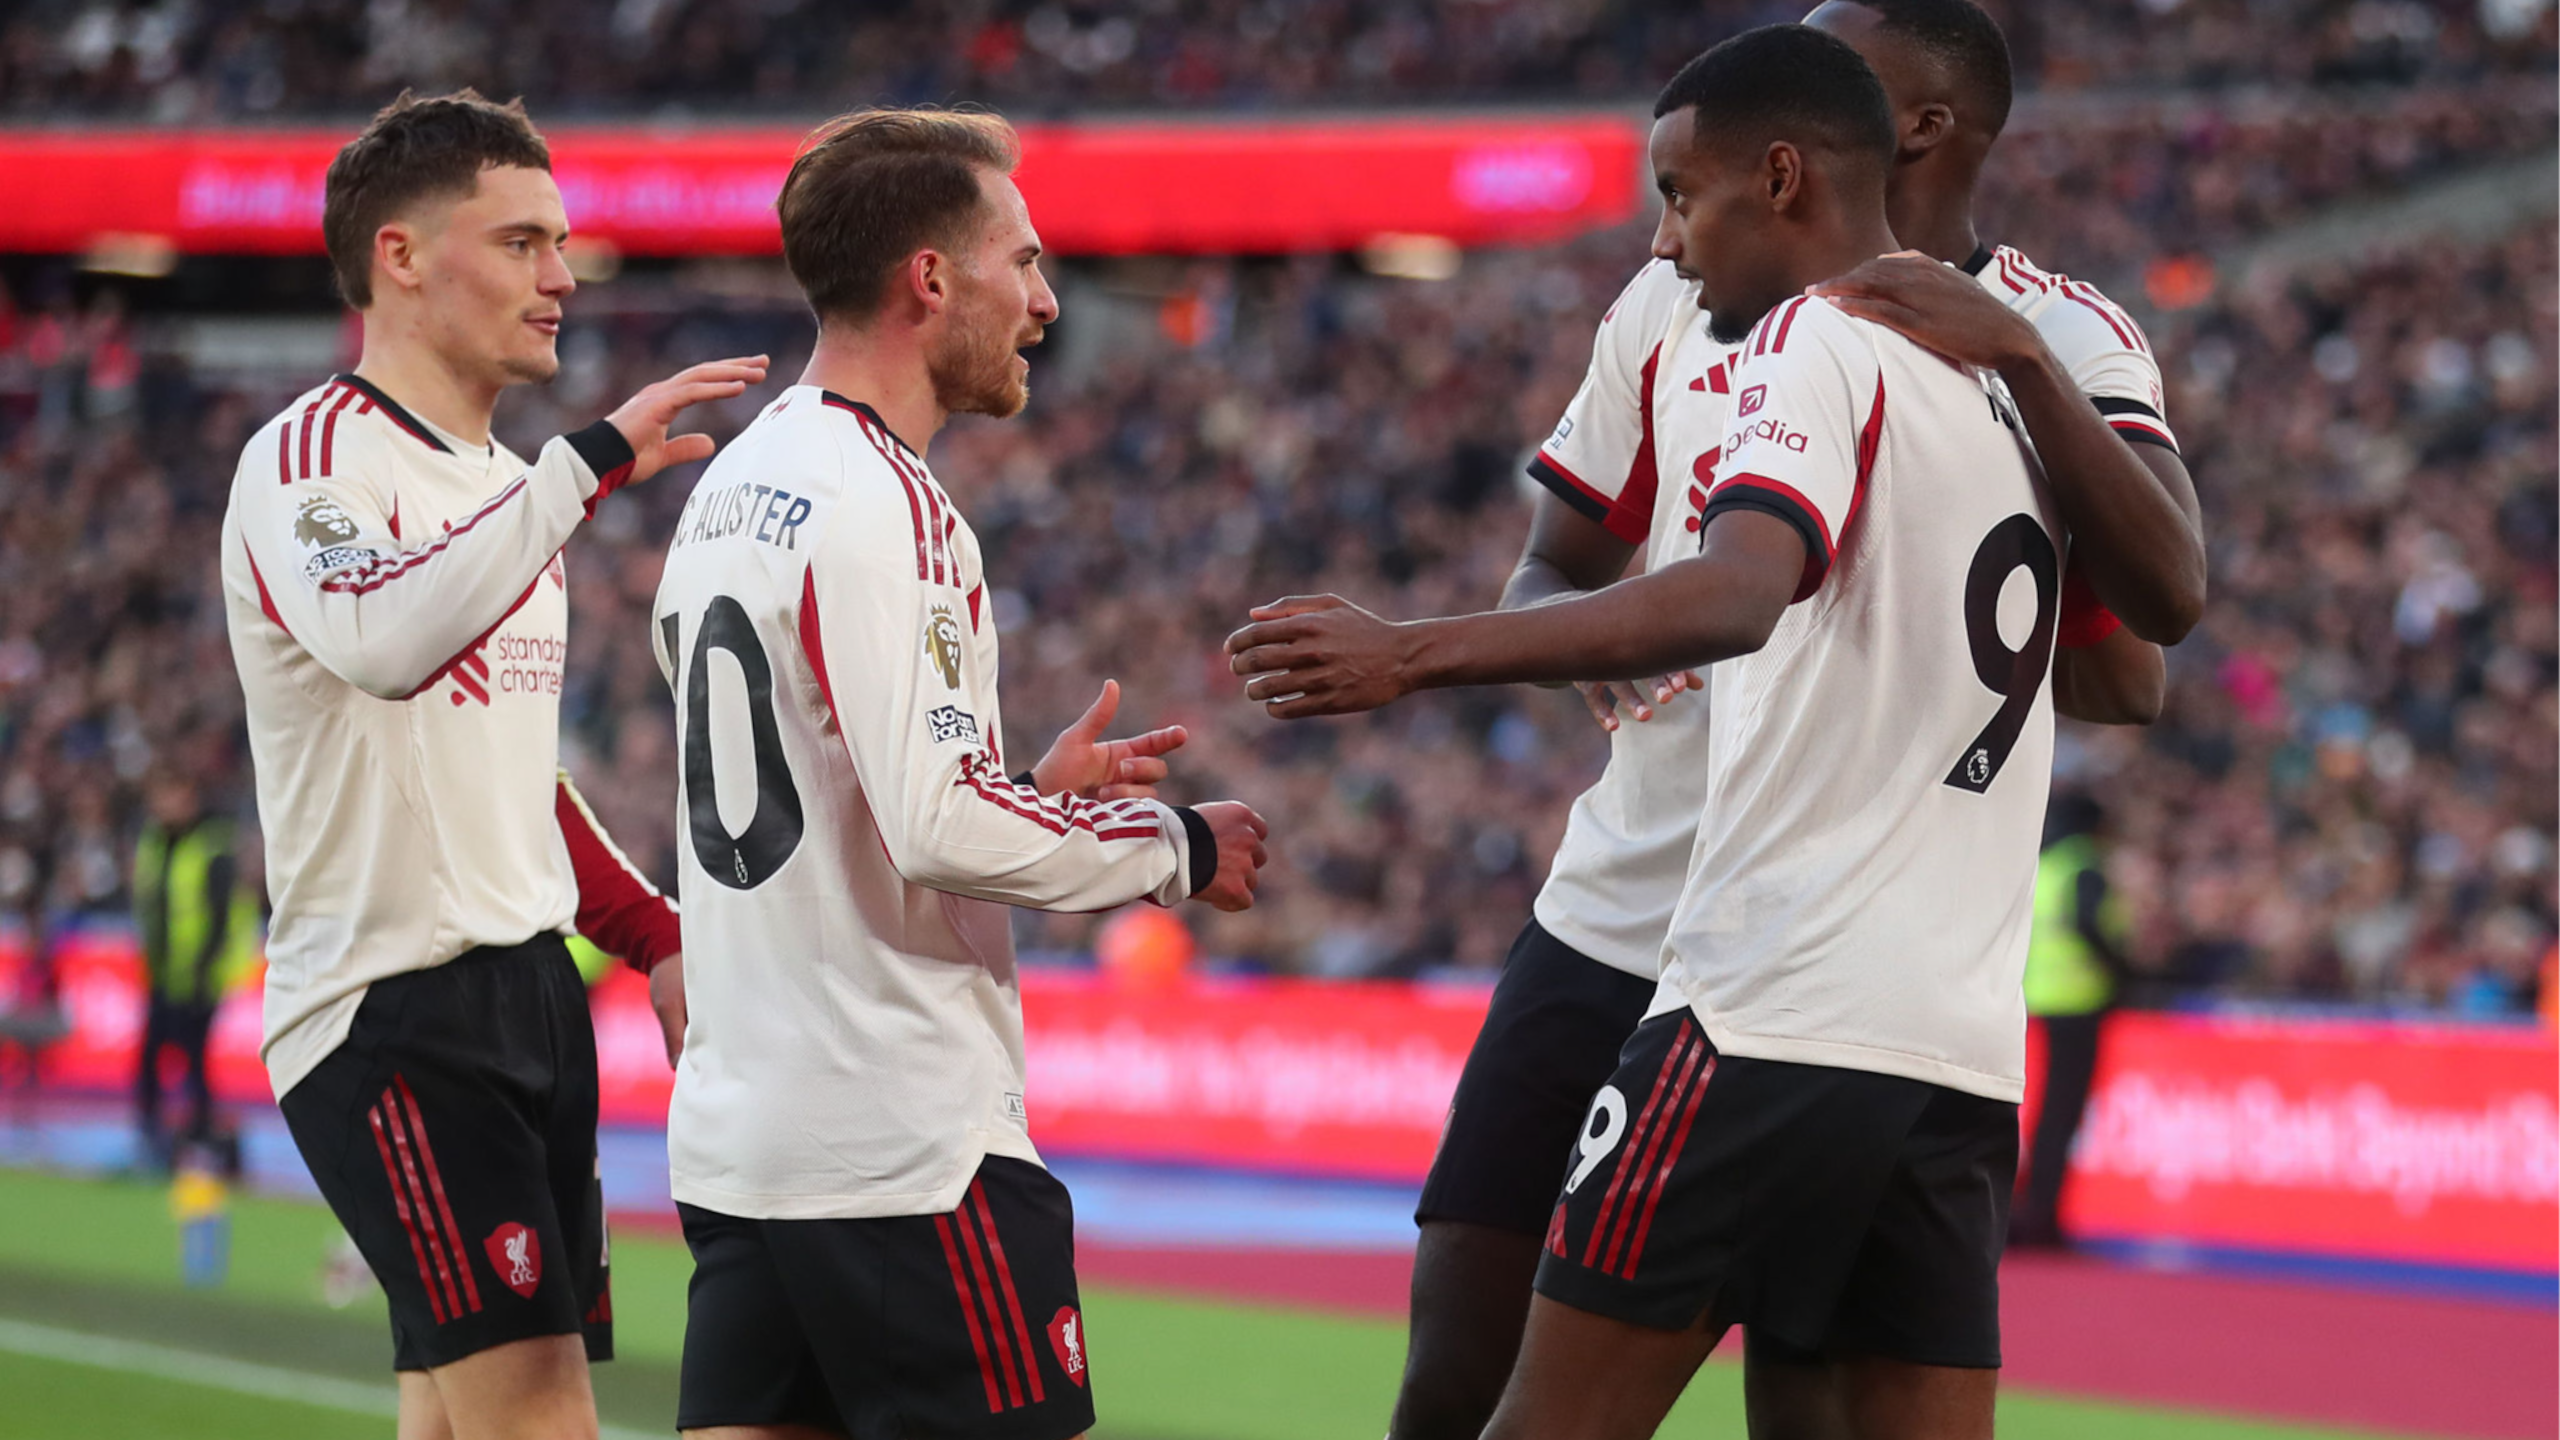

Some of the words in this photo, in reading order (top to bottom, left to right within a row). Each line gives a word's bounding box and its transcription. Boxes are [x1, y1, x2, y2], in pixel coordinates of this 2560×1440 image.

[1722, 419, 1808, 462] pedia
[672, 494, 697, 551] C
[691, 482, 812, 550] ALLISTER
[1941, 511, 2059, 795] 9
[1565, 1084, 1627, 1194] 9
[510, 1270, 537, 1286] LFC
[1067, 1356, 1085, 1374] LFC
